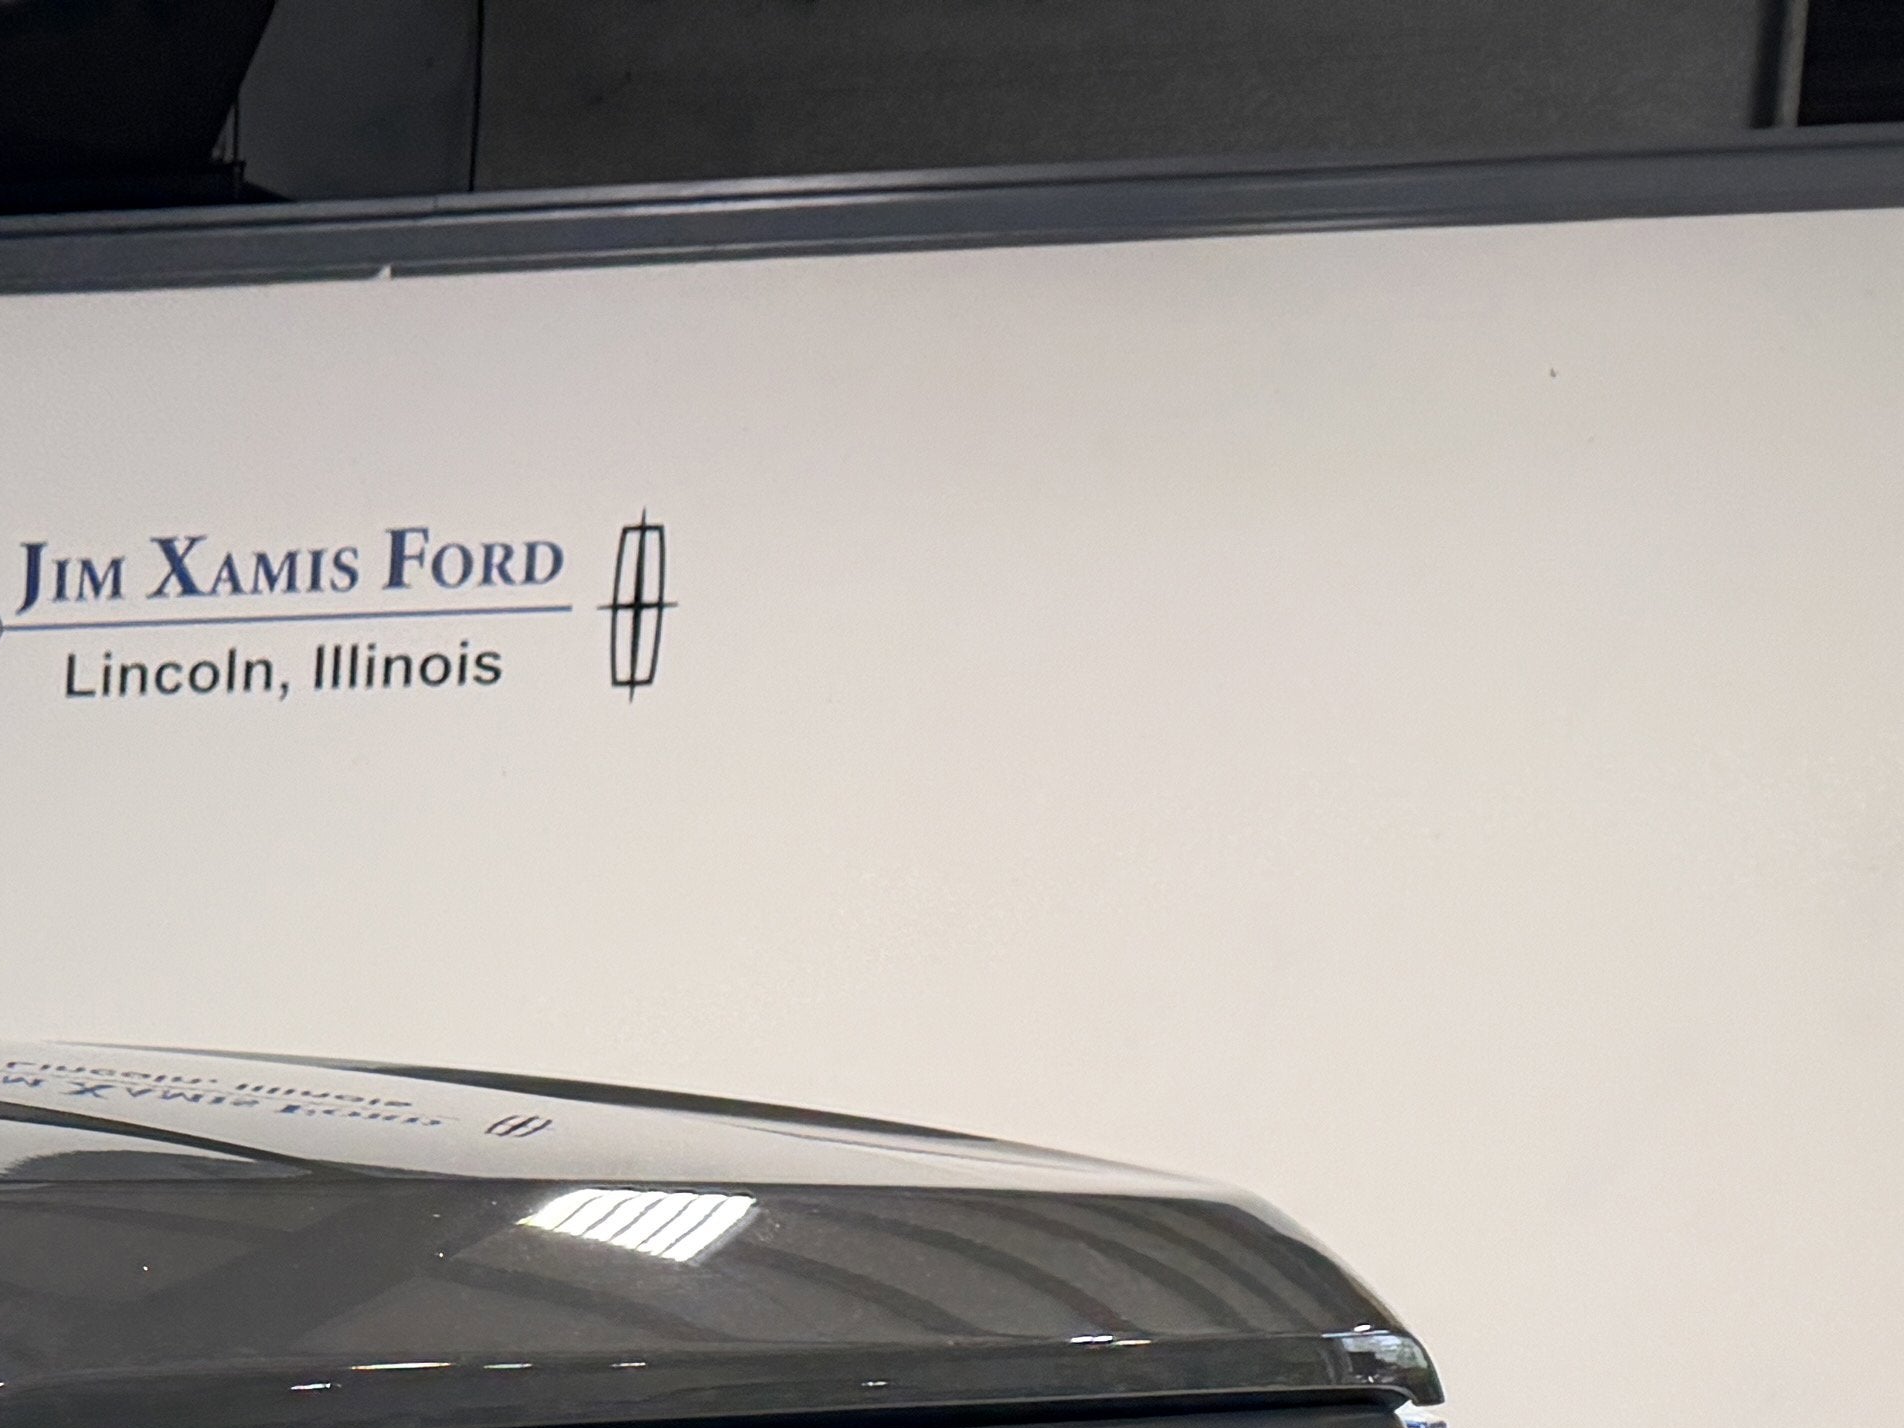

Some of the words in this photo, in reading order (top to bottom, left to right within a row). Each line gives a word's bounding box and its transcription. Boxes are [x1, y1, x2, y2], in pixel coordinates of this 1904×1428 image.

[14, 539, 124, 616] JIM
[145, 534, 361, 601] XAMIS
[381, 526, 566, 591] FORD
[64, 648, 292, 703] Lincoln,
[313, 641, 504, 692] Illinois
